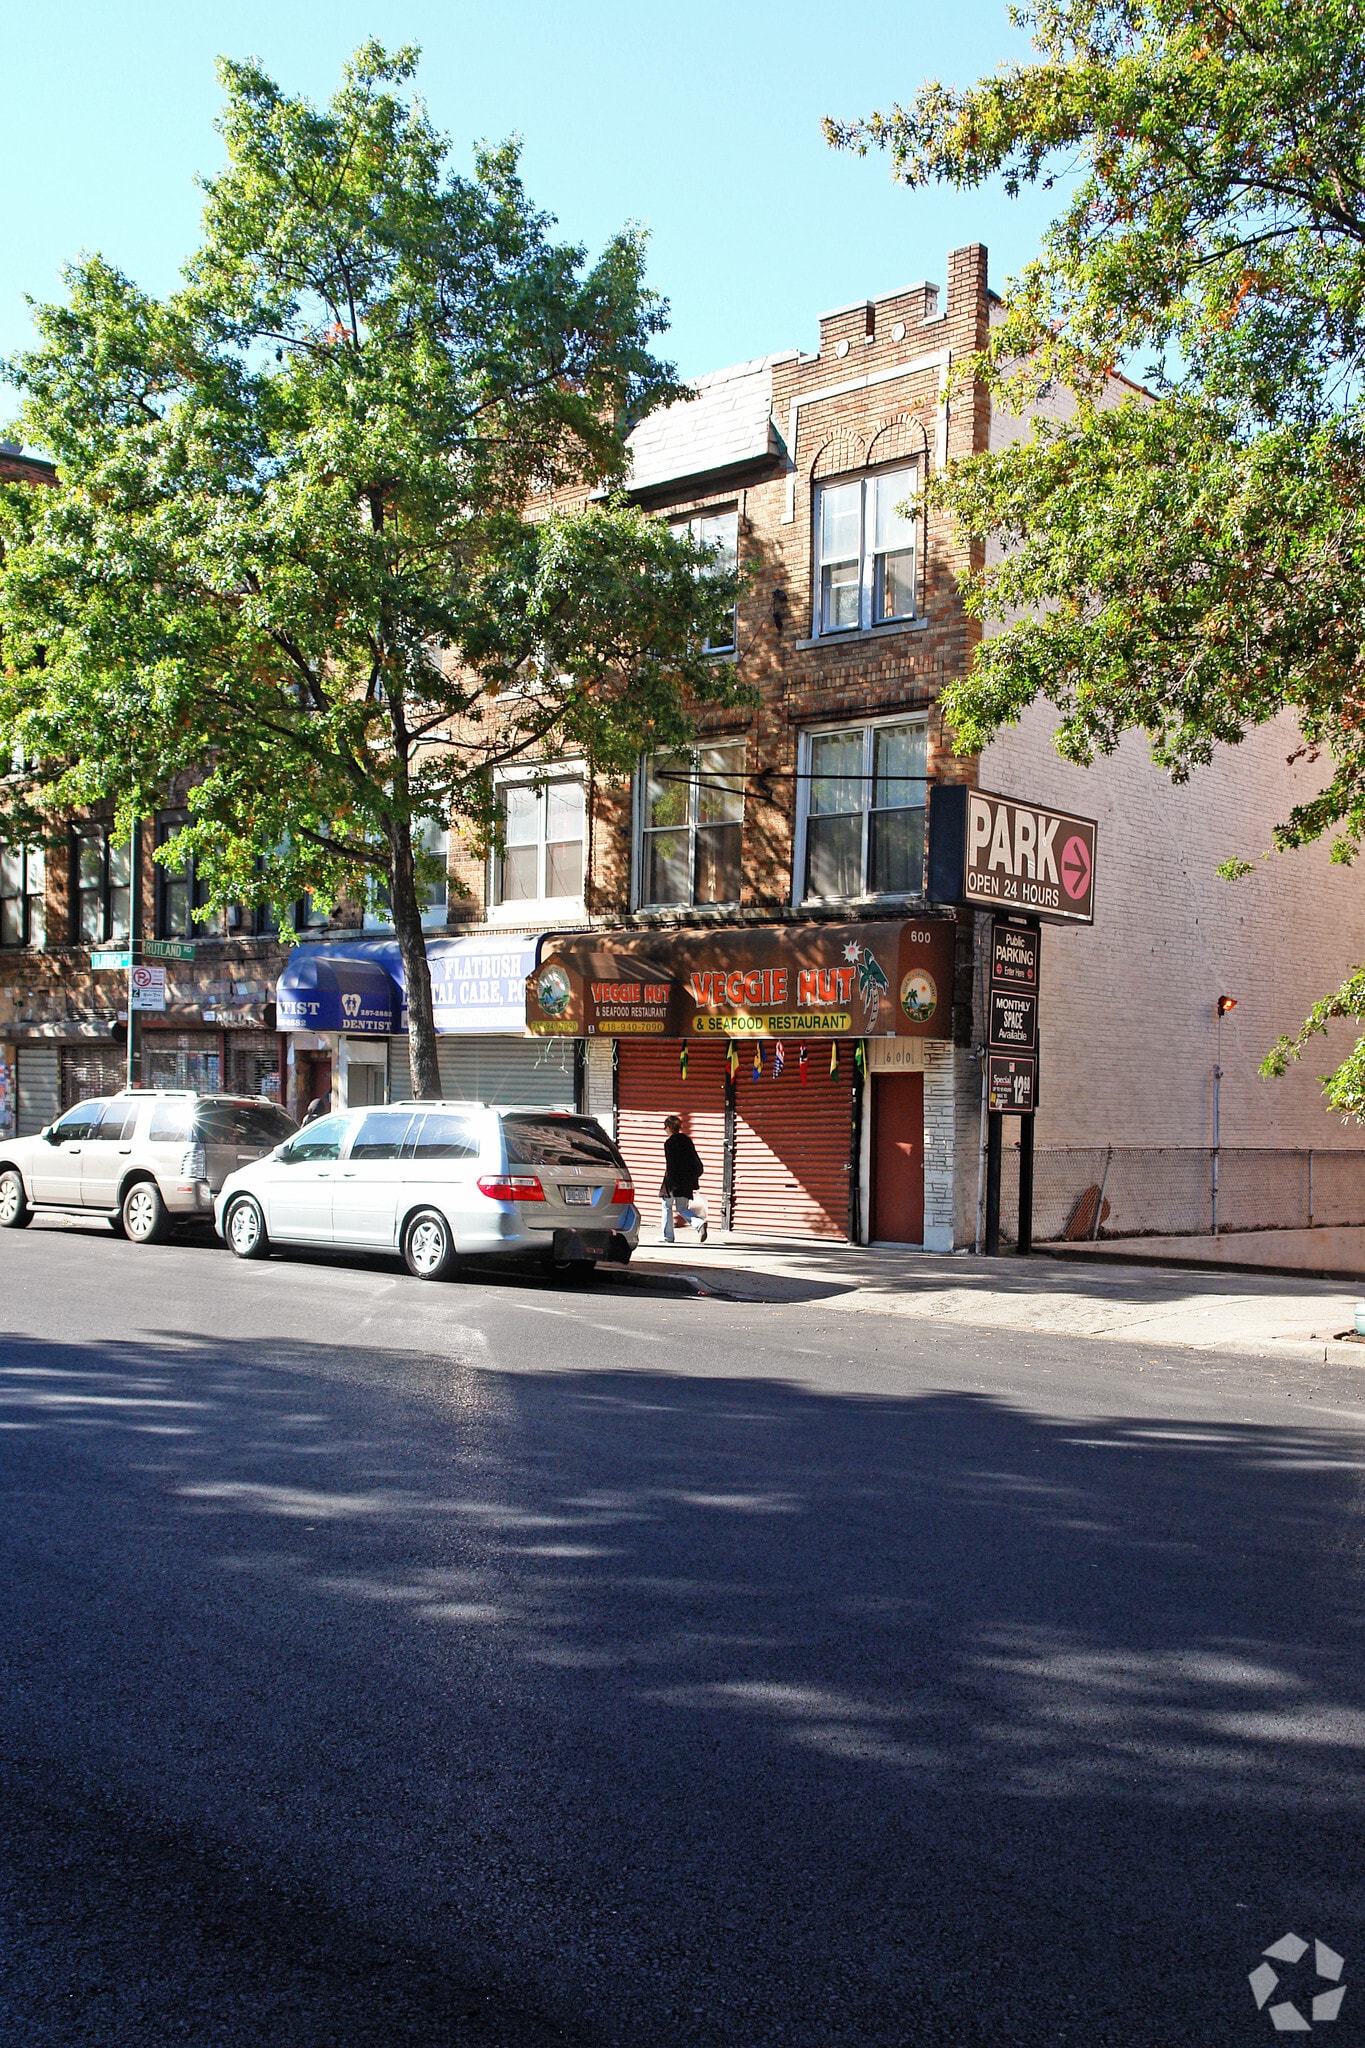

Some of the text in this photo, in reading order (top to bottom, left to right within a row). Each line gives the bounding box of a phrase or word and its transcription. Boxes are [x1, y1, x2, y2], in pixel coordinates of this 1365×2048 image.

[968, 797, 1060, 885] PARK
[968, 872, 1059, 907] OPEN 24 HOURS
[910, 930, 931, 944] 600
[1006, 934, 1026, 948] Public
[146, 942, 182, 958] RUTLAND
[996, 945, 1034, 966] PARKING
[444, 954, 522, 980] FLATBUSH
[1004, 965, 1014, 976] Enter
[402, 983, 456, 1005] DTAL
[460, 980, 504, 1006] CARE,
[591, 983, 671, 1003] VEGGIE HUT
[690, 968, 788, 1008] VEGGIE
[796, 966, 856, 1006] HUT
[996, 998, 1030, 1011] MONTHLY
[596, 1007, 666, 1017] & SEAFOOD RESTAURANT
[342, 1019, 392, 1030] DENTIST
[532, 1022, 576, 1031] 718-940-7090
[601, 1022, 662, 1031] 718-940-7090
[697, 1015, 846, 1030] & SEAFOOD RESTAURANT
[1004, 1011, 1023, 1029] SPACE
[999, 1028, 1027, 1041] Available
[886, 1052, 911, 1064] 600
[994, 1074, 1011, 1086] Special
[1014, 1076, 1024, 1103] 12
